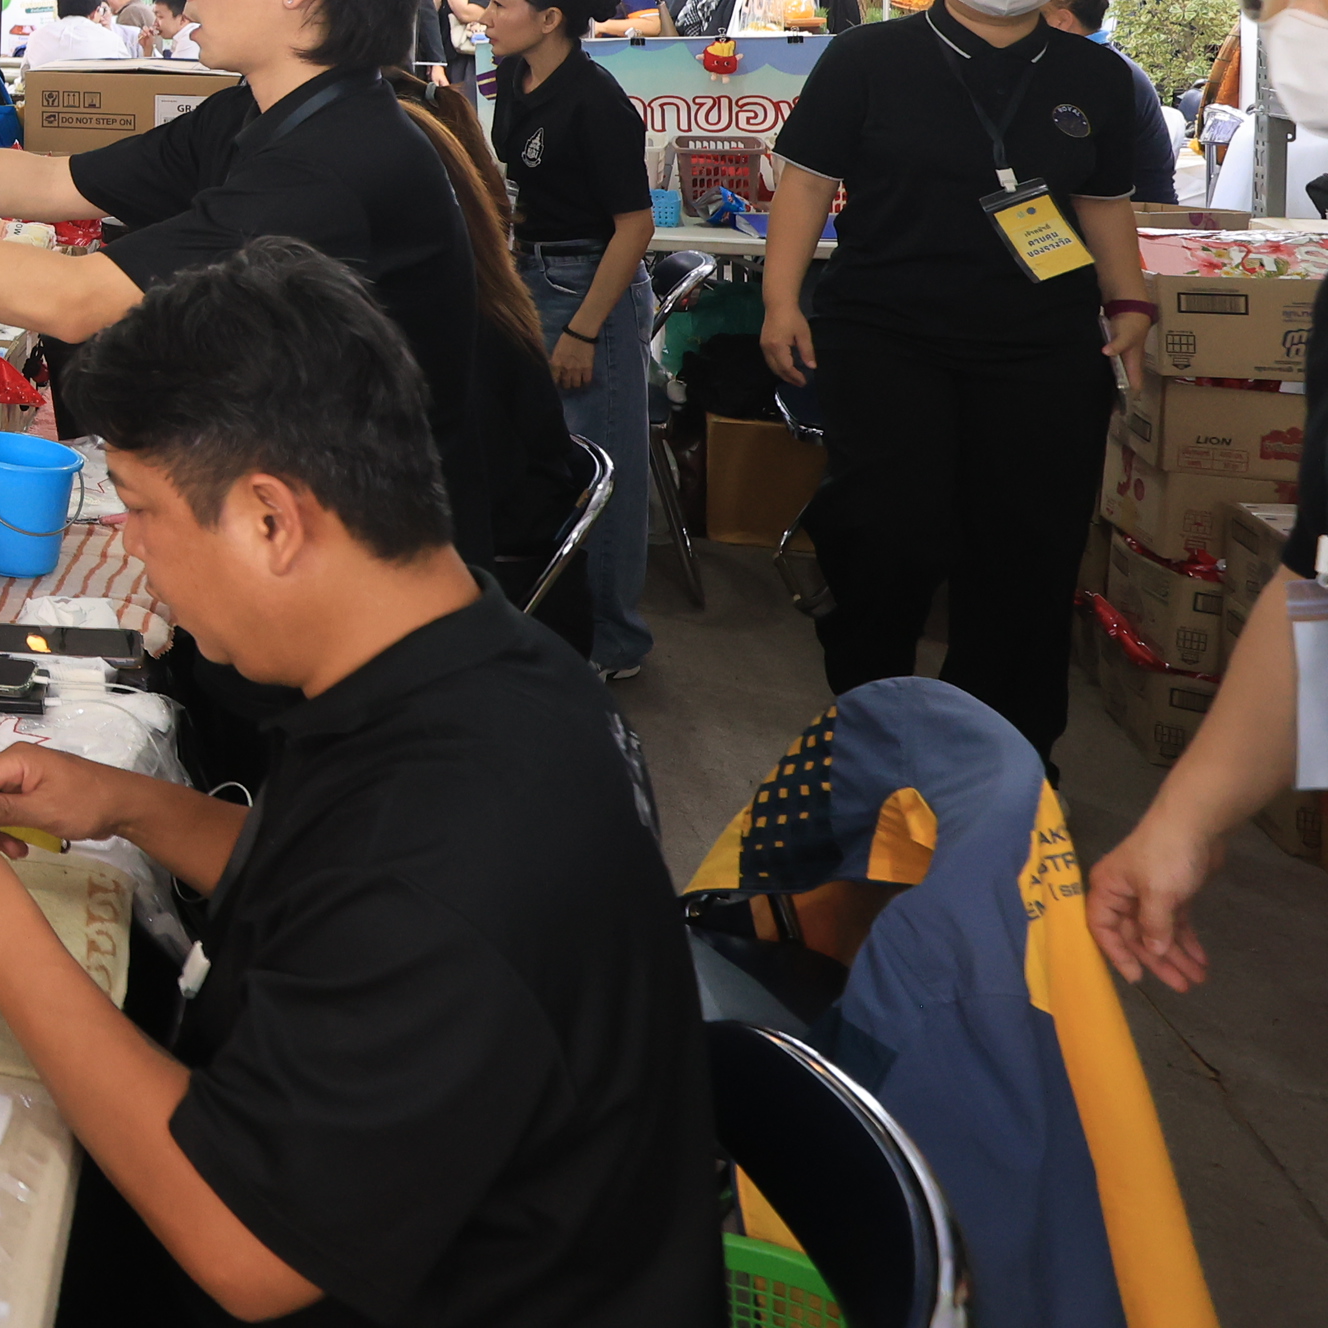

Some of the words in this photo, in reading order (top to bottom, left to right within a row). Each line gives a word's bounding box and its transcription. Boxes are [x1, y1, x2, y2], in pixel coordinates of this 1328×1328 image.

[177, 104, 199, 112] GR-
[61, 116, 74, 124] DO
[75, 117, 93, 125] NOT
[95, 118, 117, 126] STEP
[119, 118, 133, 126] ON
[1196, 435, 1233, 446] LION
